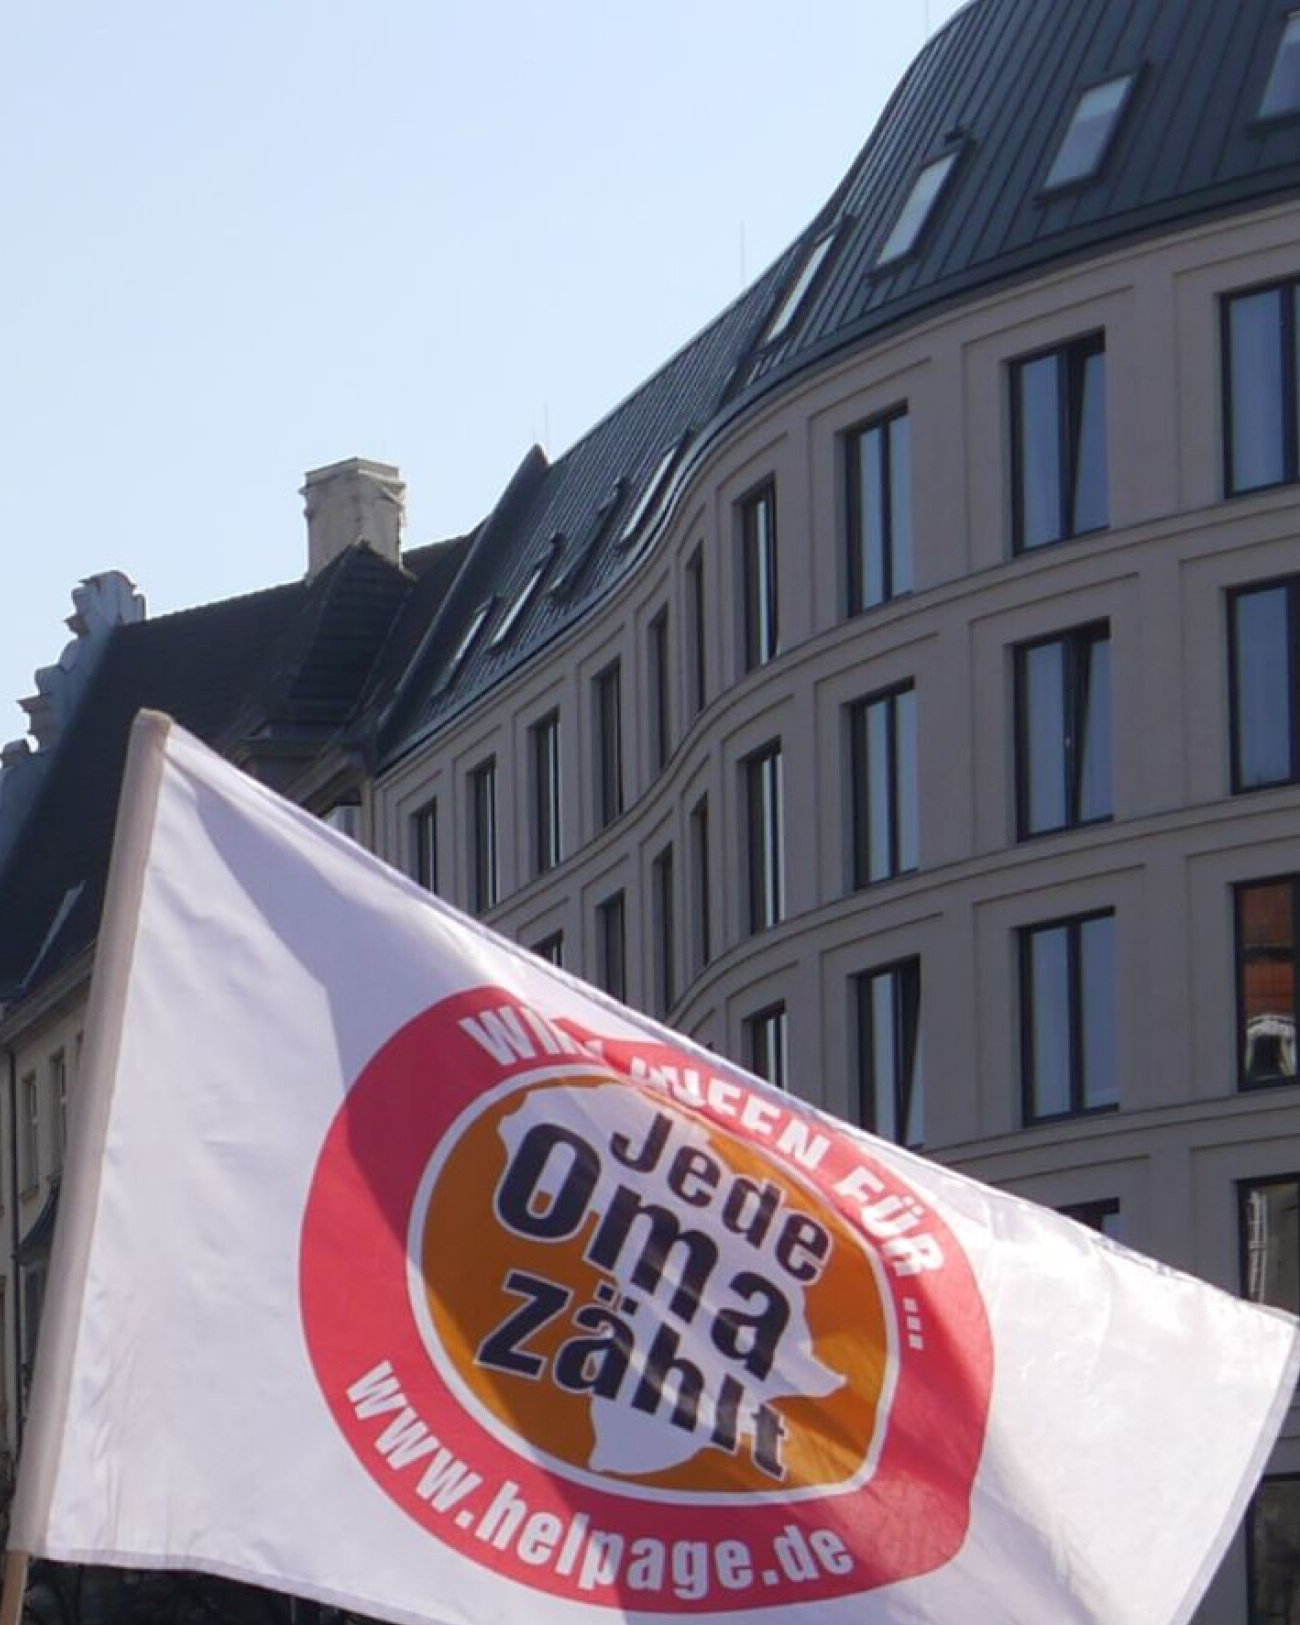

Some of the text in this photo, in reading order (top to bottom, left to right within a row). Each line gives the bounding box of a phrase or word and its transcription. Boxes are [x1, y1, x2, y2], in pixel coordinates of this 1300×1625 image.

[496, 1123, 790, 1382] Oma
[610, 1113, 829, 1282] Jede
[346, 1360, 855, 1597] www.helpage.de
